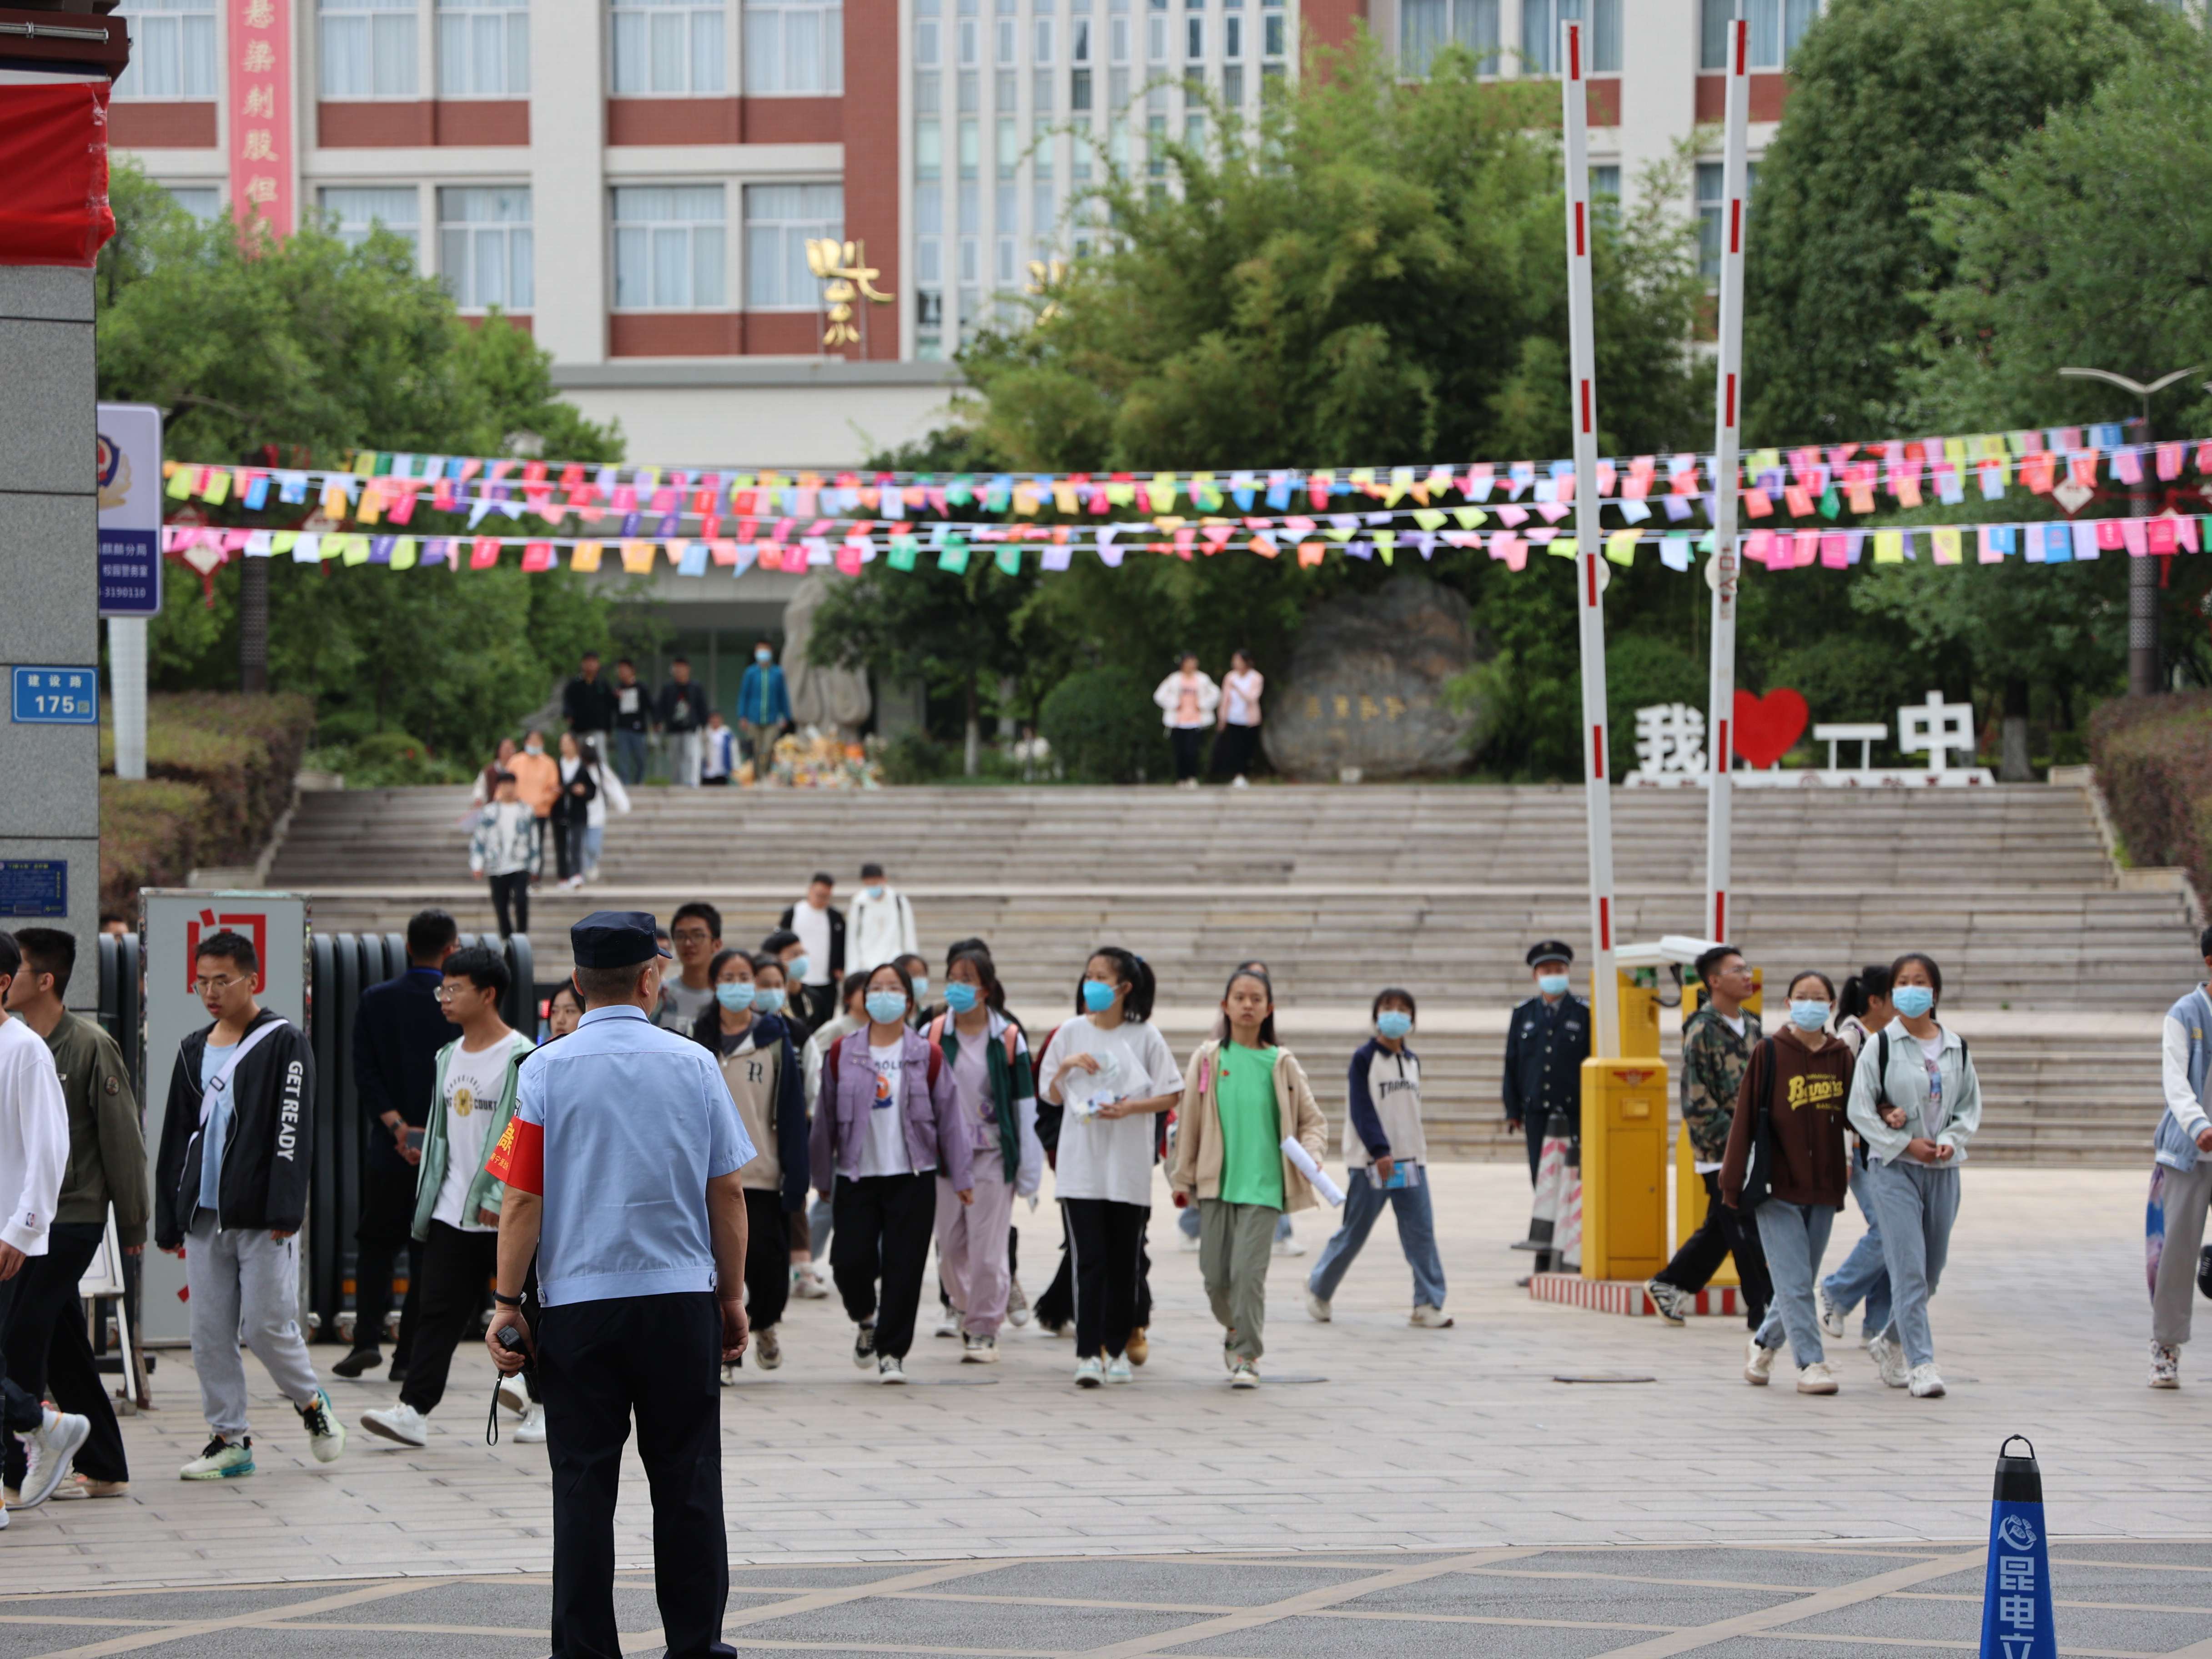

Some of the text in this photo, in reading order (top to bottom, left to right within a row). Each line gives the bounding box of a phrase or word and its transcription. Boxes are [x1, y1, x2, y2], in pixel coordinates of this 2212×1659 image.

[98, 543, 147, 556] 麒麟分局
[35, 695, 75, 714] 175
[1634, 690, 1975, 774] 我 一中
[277, 1060, 303, 1162] GET READY
